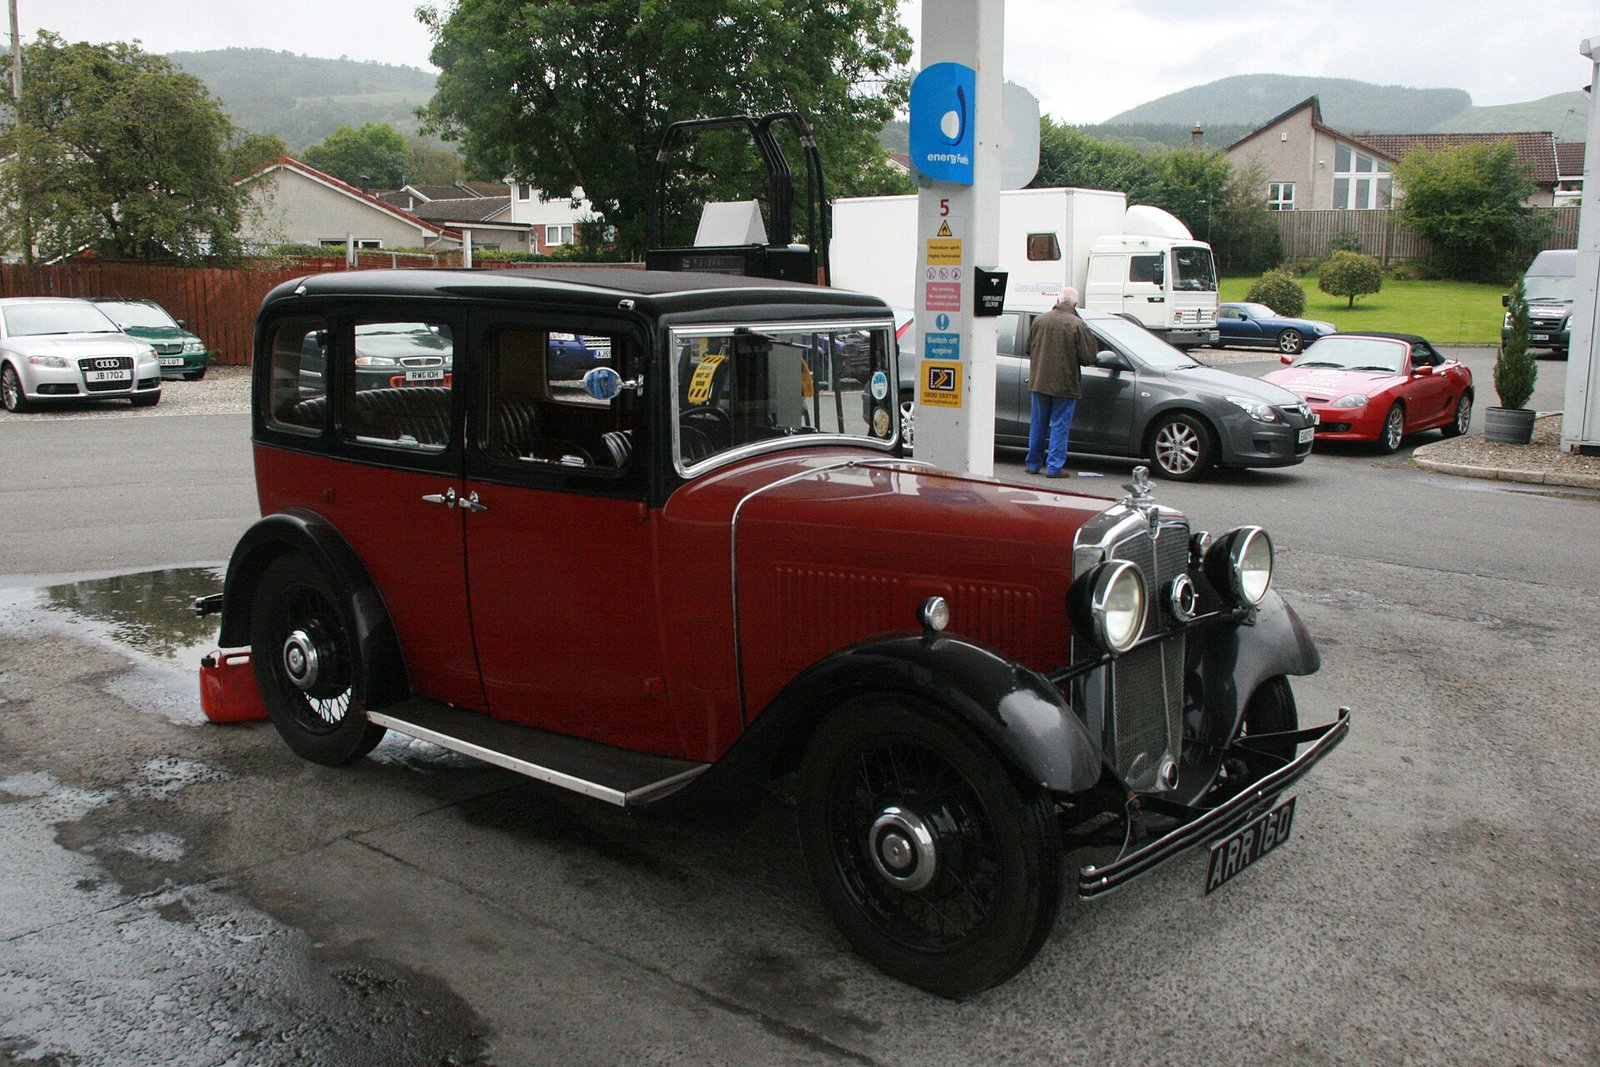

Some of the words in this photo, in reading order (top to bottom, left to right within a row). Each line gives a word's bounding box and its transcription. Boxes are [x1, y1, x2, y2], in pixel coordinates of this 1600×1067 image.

[927, 153, 957, 164] energy
[940, 199, 950, 217] 5
[927, 336, 948, 344] Switch
[948, 337, 958, 345] off
[931, 347, 953, 356] engine
[95, 372, 105, 380] JB
[106, 371, 124, 379] 1702
[1209, 829, 1254, 890] ARR
[1257, 805, 1290, 856] 160
